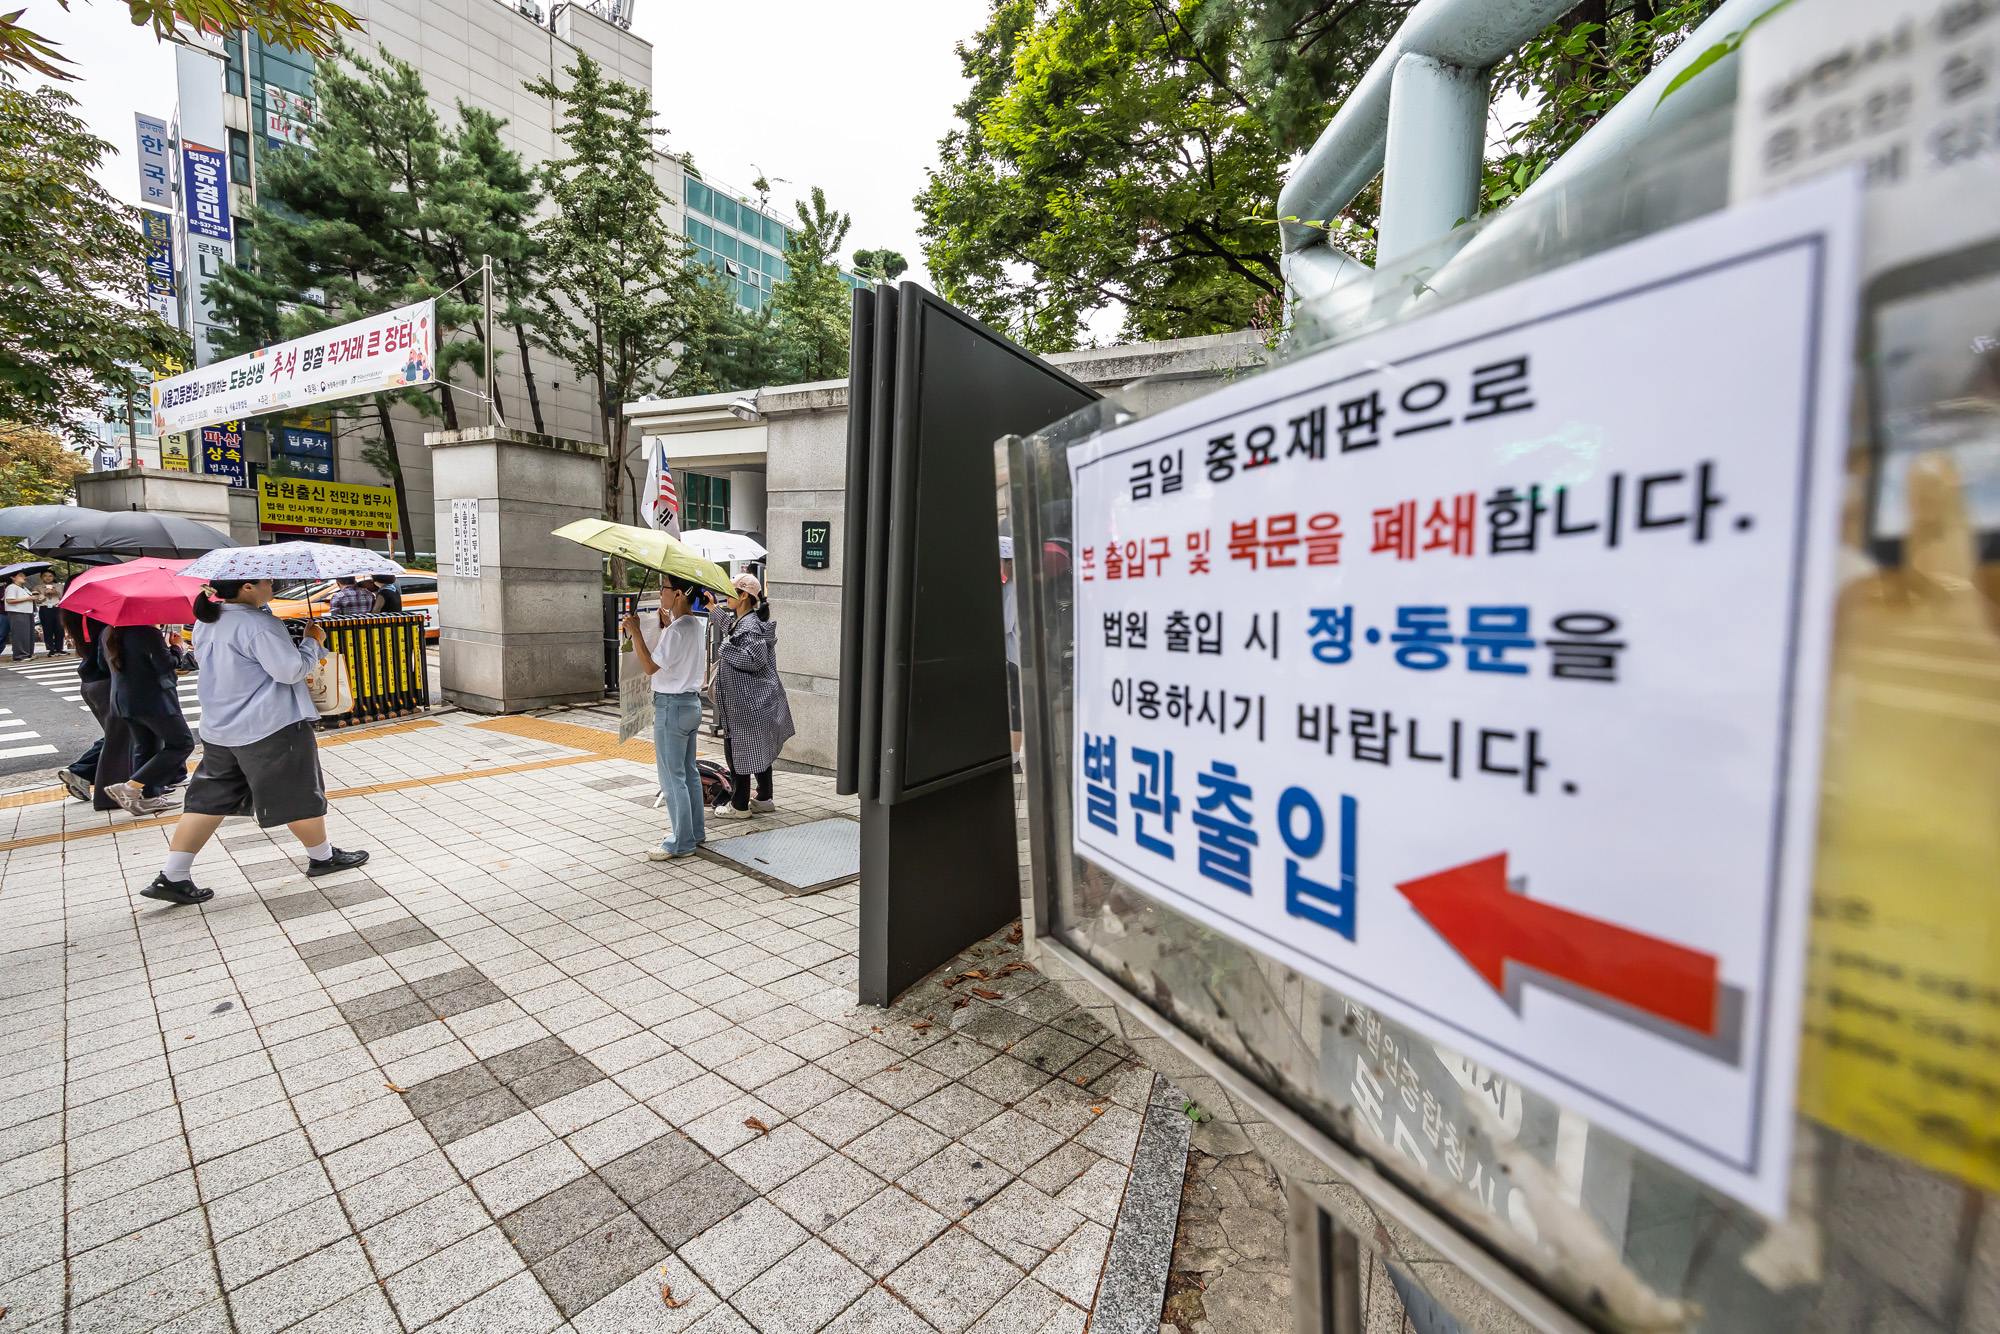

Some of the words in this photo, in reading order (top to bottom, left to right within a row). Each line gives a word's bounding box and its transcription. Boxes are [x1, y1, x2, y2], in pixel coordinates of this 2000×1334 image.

[140, 134, 166, 185] 한국
[188, 151, 220, 167] 법무사
[149, 187, 163, 197] 5F
[194, 163, 220, 223] 유경민
[229, 362, 265, 391] 도농상생
[270, 347, 297, 385] 추석
[302, 345, 324, 372] 명절
[328, 334, 364, 365] 직거래
[367, 330, 380, 357] 큰
[385, 322, 412, 353] 장터
[204, 430, 241, 448] 파산
[1129, 449, 1184, 500] 금일
[1205, 355, 1537, 483] 중요재판으로
[206, 447, 241, 463] 상속
[288, 436, 327, 450] 법무사
[209, 464, 240, 474] 법무사
[265, 482, 325, 502] 법원출신
[329, 490, 359, 505] 전민갑
[363, 493, 392, 508] 법무사
[267, 502, 285, 511] 법원
[304, 526, 365, 537] 010-3020-0773
[1082, 546, 1095, 582] 본
[1104, 534, 1171, 580] 출입구
[1188, 528, 1211, 575] 및
[1228, 511, 1345, 571] 북문을
[1371, 460, 1755, 560] 폐쇄합니다.
[470, 502, 479, 576] 서울고등법원
[805, 528, 826, 543] 157
[1102, 610, 1149, 651] 법원
[1164, 609, 1223, 655] 출입
[1244, 610, 1280, 660] 시
[1307, 604, 1627, 683] 정·동문을
[1111, 677, 1267, 742] 이용하시기
[1298, 703, 1579, 796] 바랍니다.
[1083, 731, 1358, 943] 별관출입
